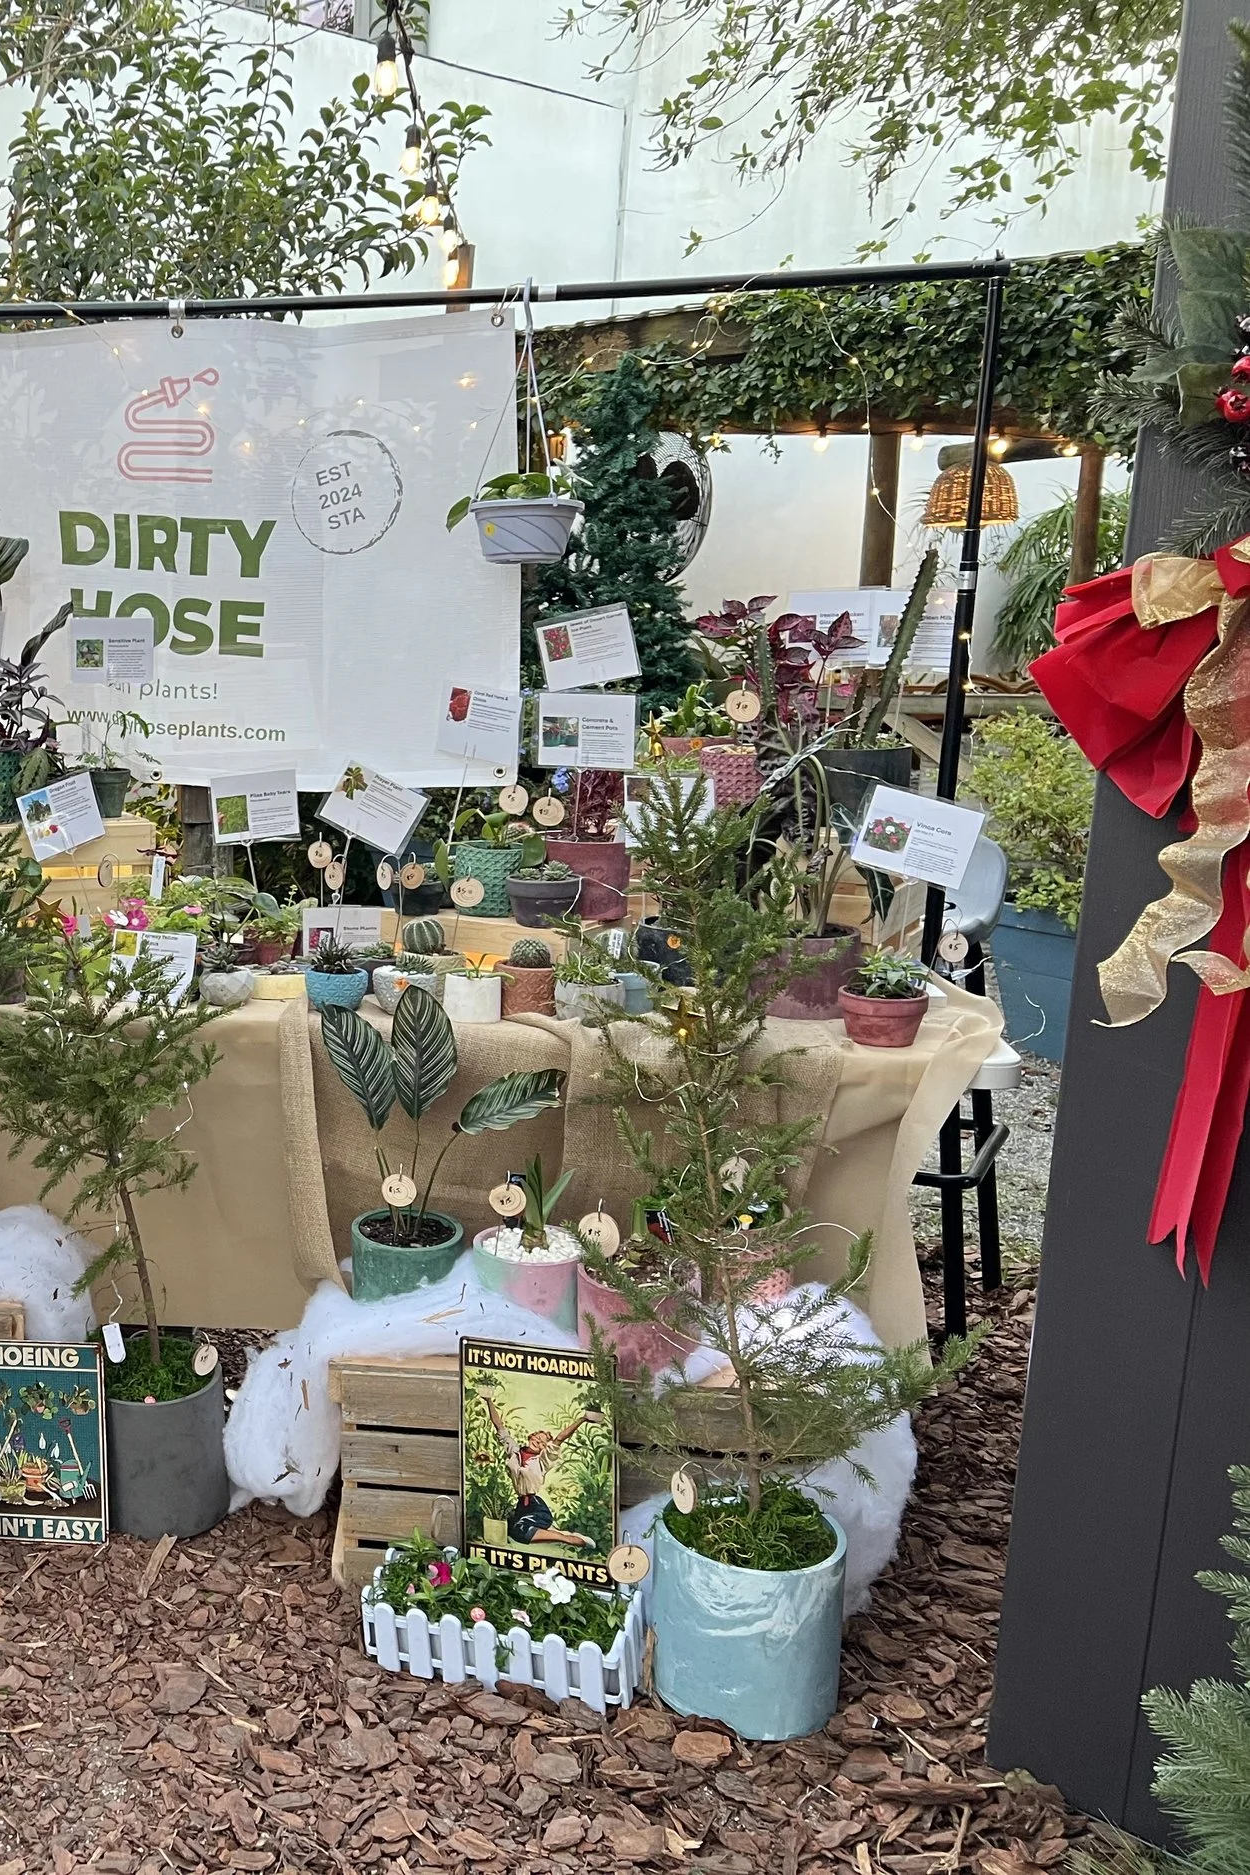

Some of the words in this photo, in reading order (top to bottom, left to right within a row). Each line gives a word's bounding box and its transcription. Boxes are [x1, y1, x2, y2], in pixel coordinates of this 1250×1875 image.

[316, 461, 352, 487] EST
[319, 483, 362, 510] 2024
[327, 507, 365, 529] STA
[59, 511, 277, 578] DIRTY
[70, 588, 265, 658] HOSE
[139, 679, 218, 700] plants!
[916, 821, 935, 832] Vinca
[468, 1348, 491, 1365] IT'S
[494, 1352, 524, 1369] NOT
[527, 1356, 595, 1378] HOARDIN
[42, 1519, 99, 1541] EASY
[469, 1546, 486, 1561] IF
[490, 1550, 524, 1569] IT'S
[528, 1556, 608, 1583] PLANTS
